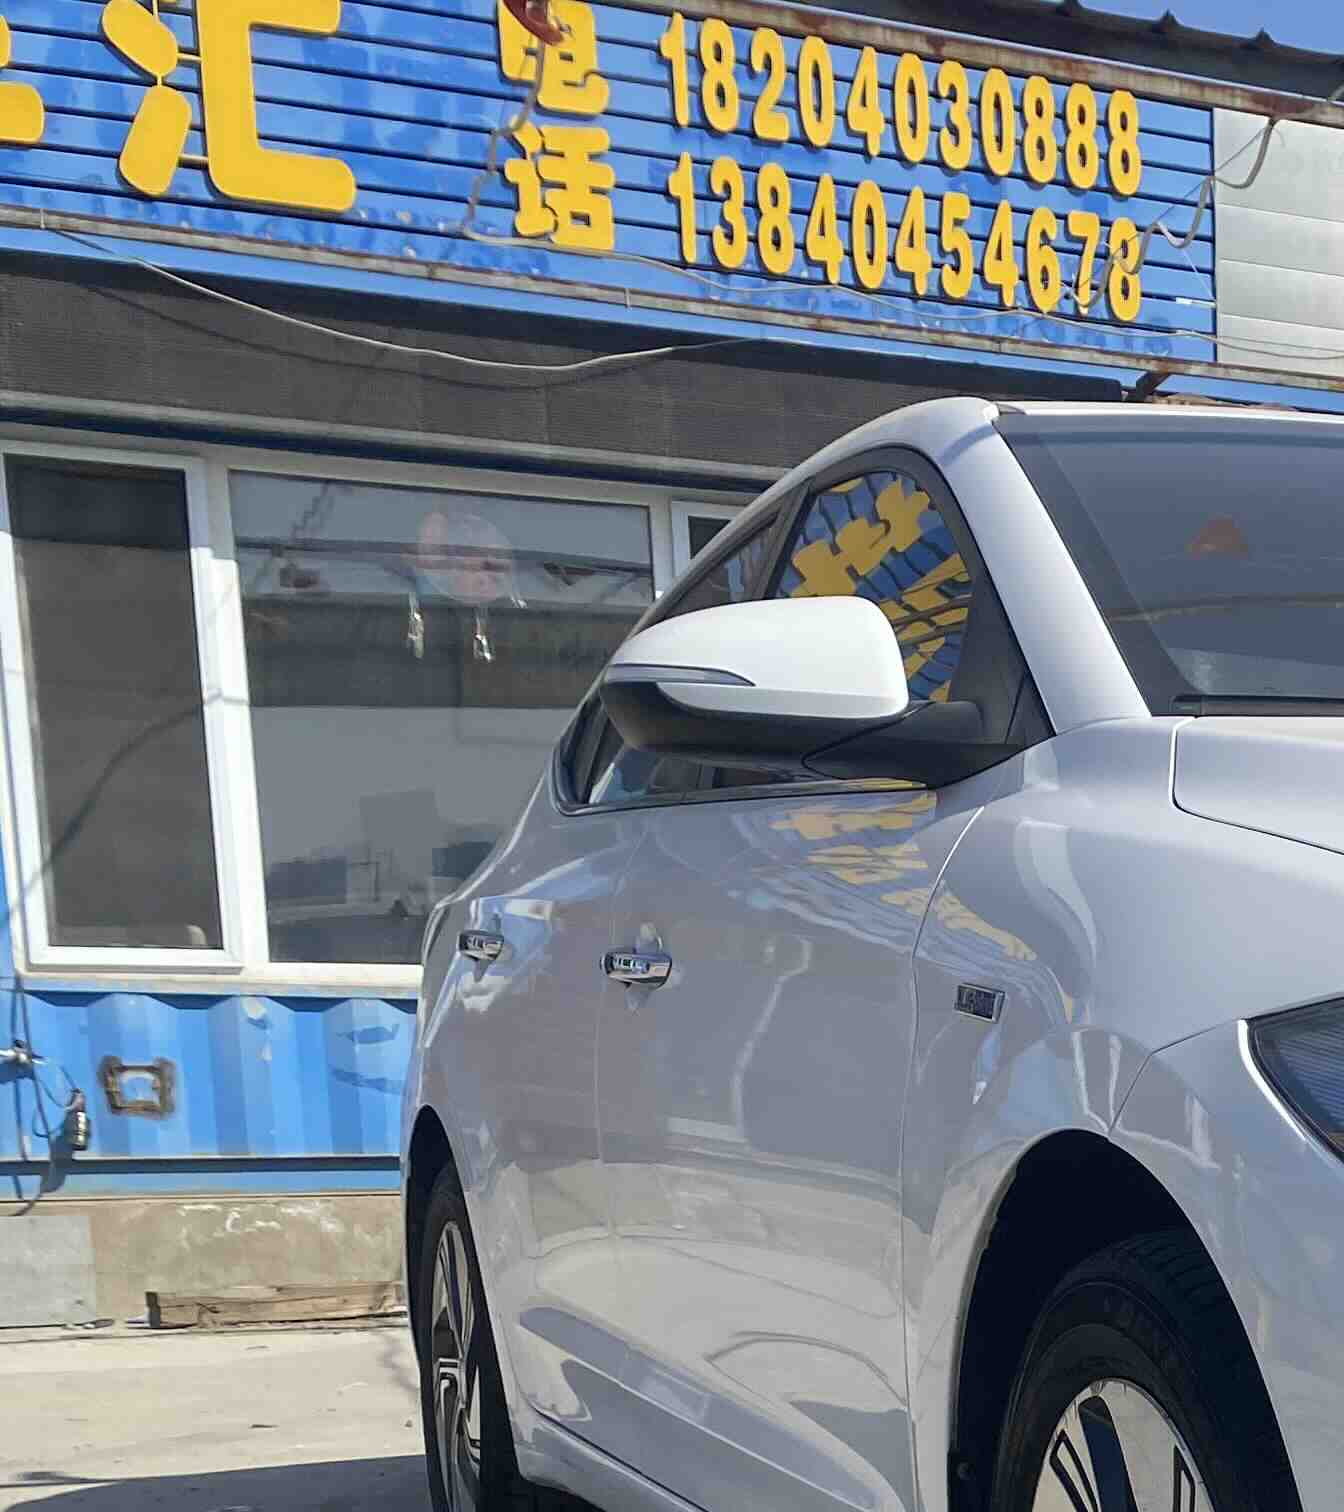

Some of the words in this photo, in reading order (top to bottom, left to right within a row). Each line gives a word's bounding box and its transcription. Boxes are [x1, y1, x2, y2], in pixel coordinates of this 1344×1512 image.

[496, 0, 615, 251] 电话
[658, 12, 1142, 197] 18204030888
[668, 152, 1142, 322] 13840454678
